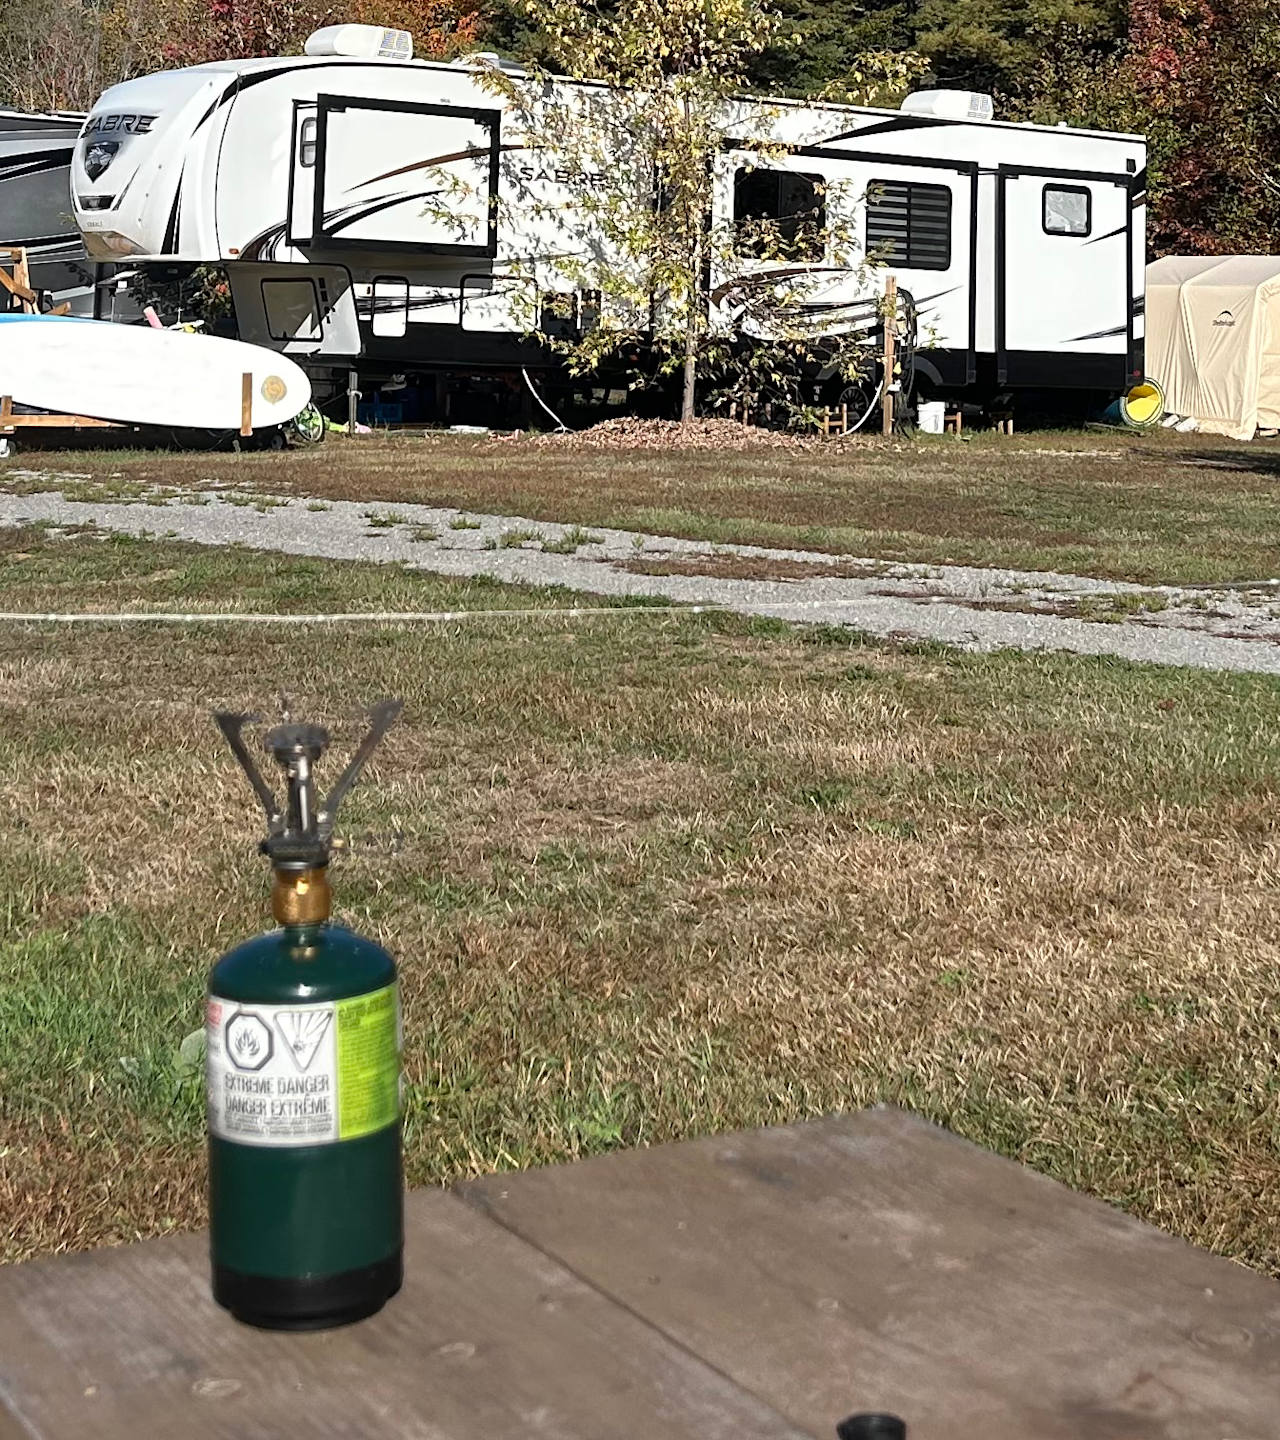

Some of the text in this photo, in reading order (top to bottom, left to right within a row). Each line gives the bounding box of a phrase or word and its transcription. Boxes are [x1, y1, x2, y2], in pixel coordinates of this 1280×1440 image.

[81, 114, 160, 138] SABRE
[225, 1072, 329, 1094] EXTREME DANGER
[225, 1095, 266, 1116] DANGER
